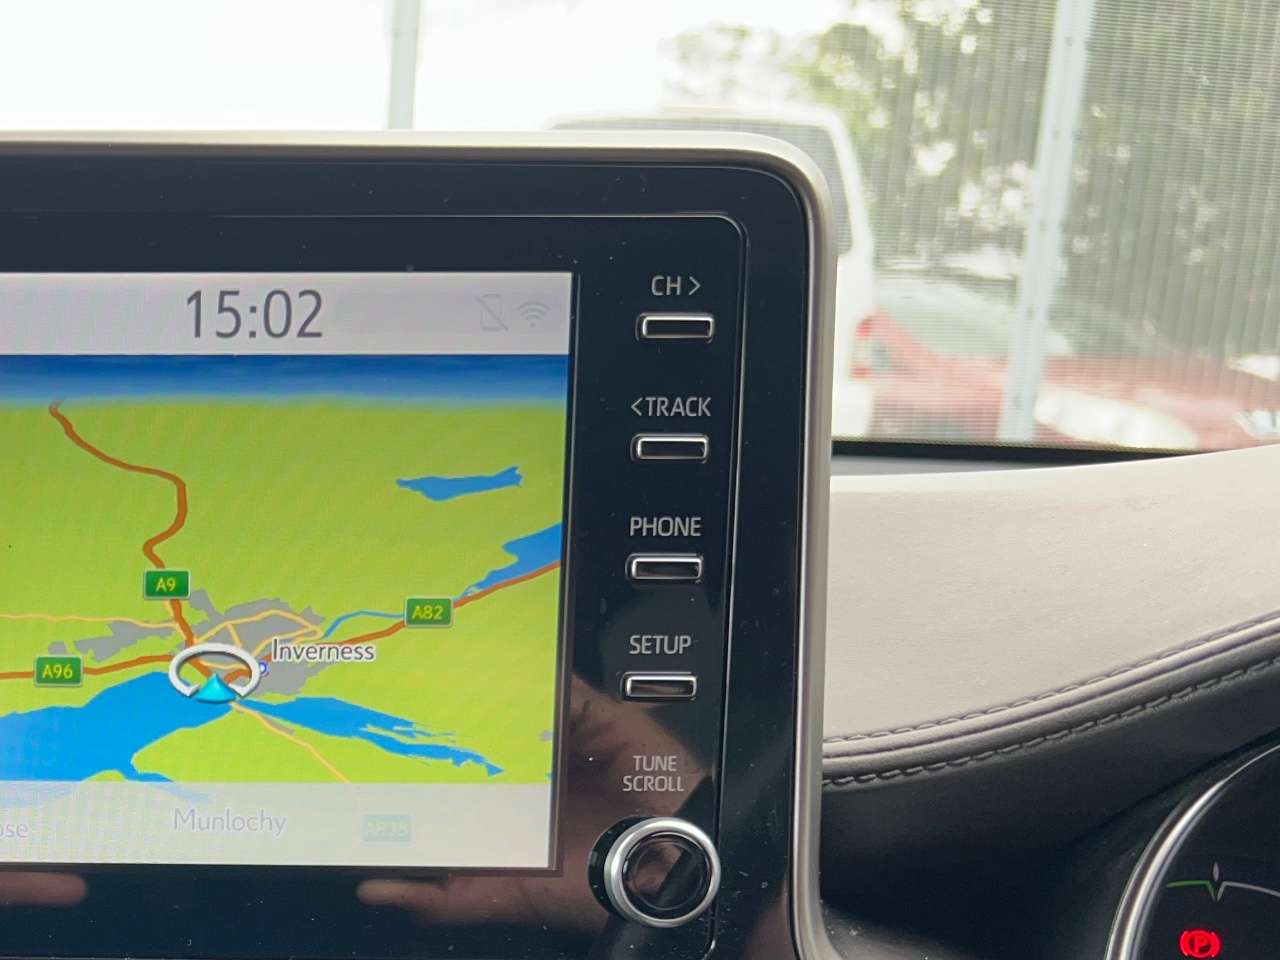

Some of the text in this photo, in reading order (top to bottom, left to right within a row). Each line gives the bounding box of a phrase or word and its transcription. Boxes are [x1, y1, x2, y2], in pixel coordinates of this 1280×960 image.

[650, 276, 681, 297] CH
[185, 289, 324, 339] 15:02
[629, 517, 702, 538] PHONE
[155, 576, 177, 593] A9
[411, 604, 444, 621] A82
[272, 638, 376, 663] Inverness
[628, 635, 692, 655] SETUP
[41, 664, 74, 680] A96
[632, 755, 678, 773] TUNE
[622, 775, 685, 793] SCROLL
[172, 808, 288, 837] Munlochy
